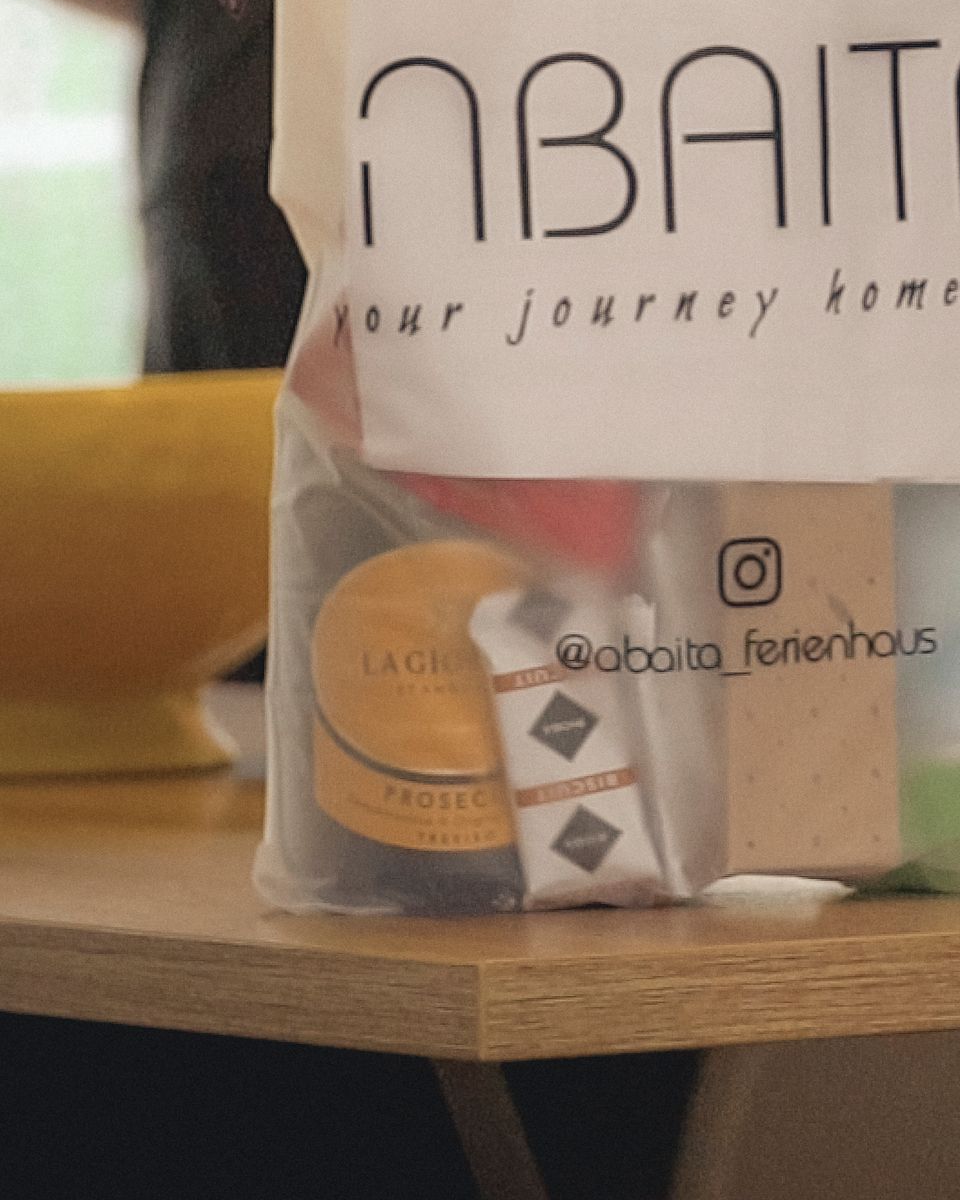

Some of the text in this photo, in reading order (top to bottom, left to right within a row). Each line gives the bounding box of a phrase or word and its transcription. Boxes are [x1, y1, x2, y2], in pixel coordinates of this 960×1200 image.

[333, 299, 464, 348] your
[506, 286, 779, 346] journey
[556, 619, 938, 677] @abaita_ferienhaus
